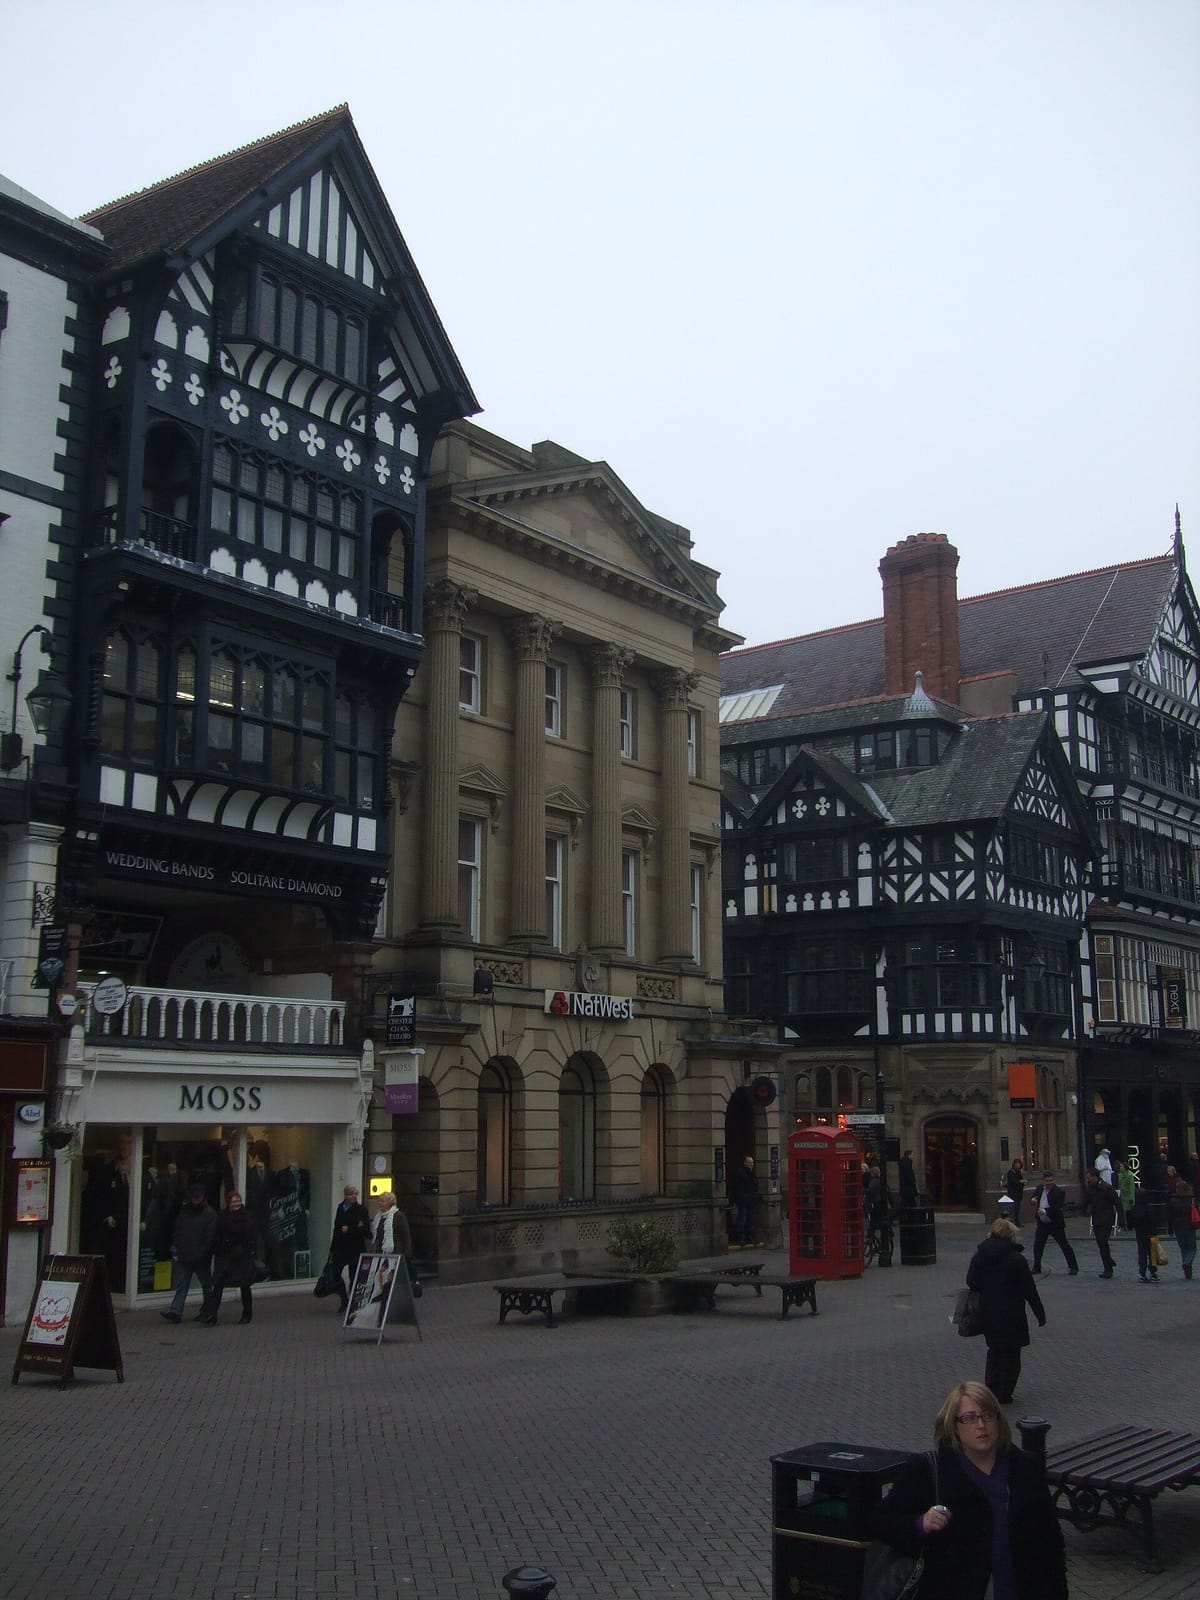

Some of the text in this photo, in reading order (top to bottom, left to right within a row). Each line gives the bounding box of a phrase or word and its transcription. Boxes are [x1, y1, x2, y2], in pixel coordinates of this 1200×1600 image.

[106, 851, 215, 881] WEDDING BANDS
[230, 870, 343, 898] SOLITARE DIAMOND
[573, 993, 634, 1019] NatWest
[1169, 984, 1180, 1013] next
[390, 1063, 412, 1072] MOSS
[178, 1084, 262, 1111] MOSS
